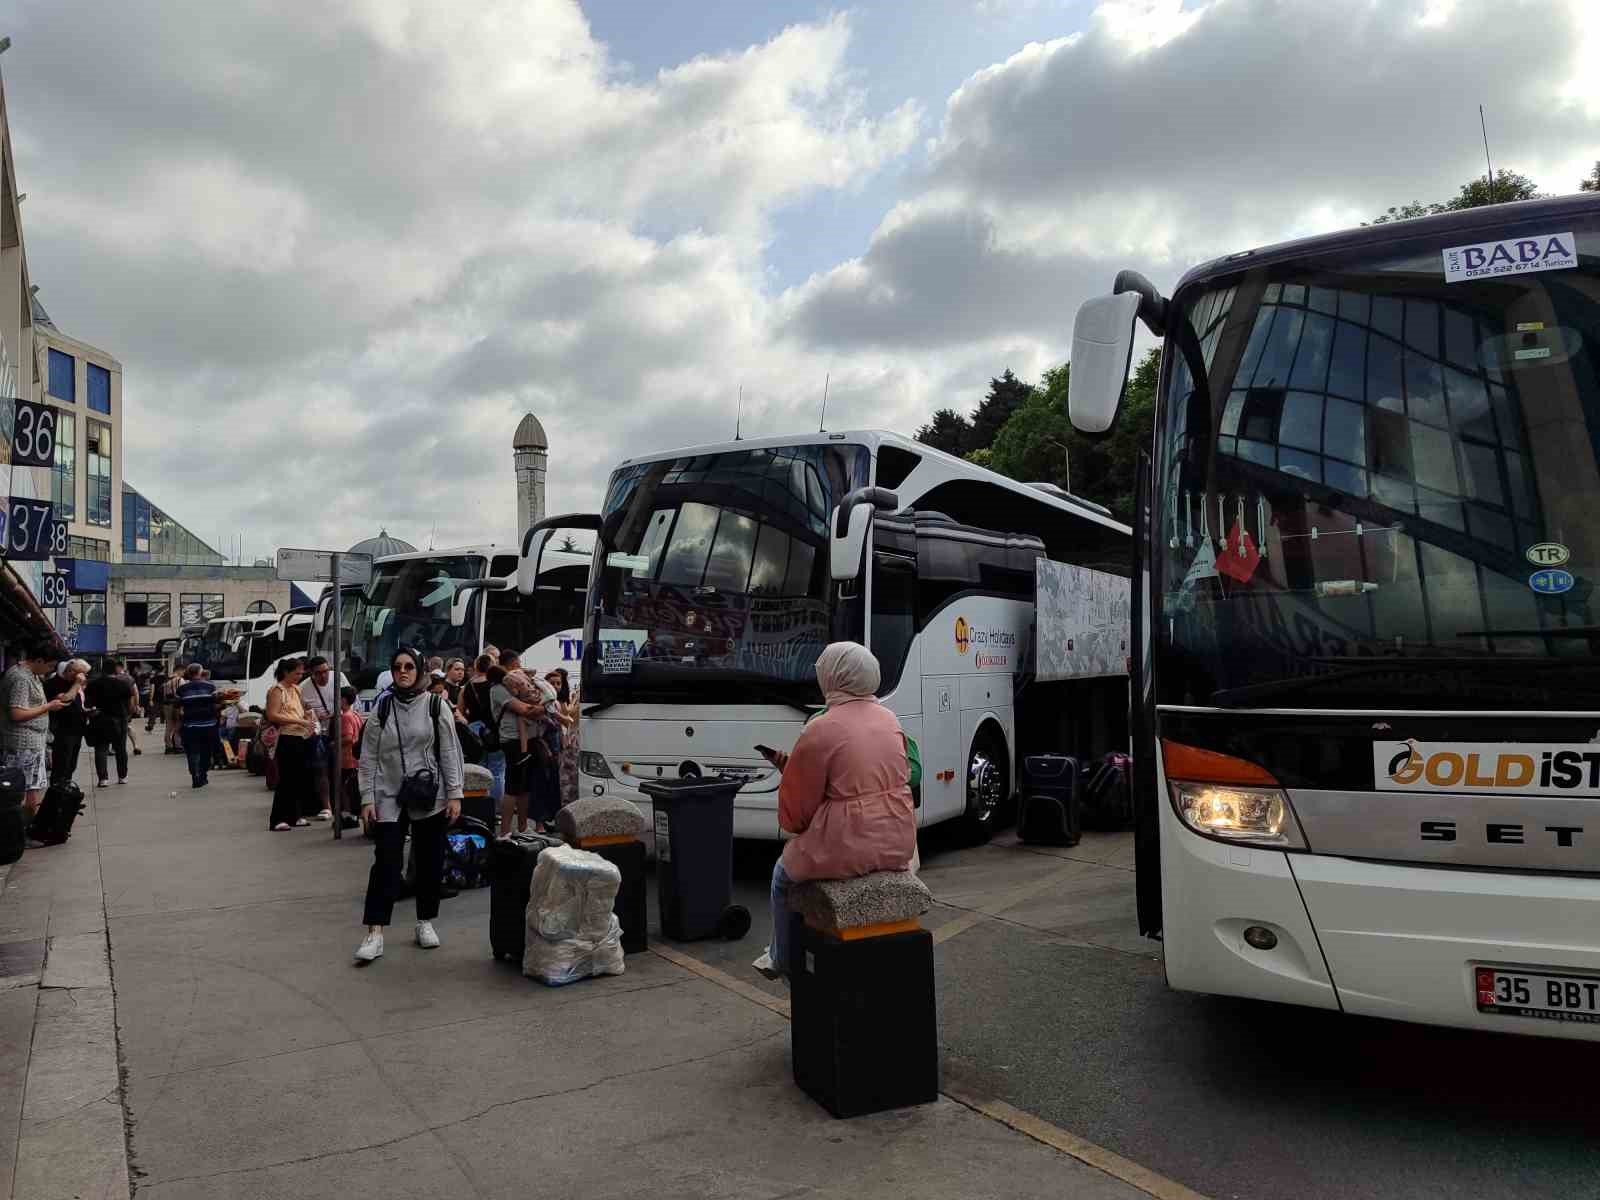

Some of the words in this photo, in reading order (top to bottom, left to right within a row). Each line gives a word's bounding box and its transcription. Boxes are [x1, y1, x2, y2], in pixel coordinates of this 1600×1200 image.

[1462, 237, 1571, 269] BABA
[15, 406, 54, 460] 36
[12, 504, 50, 553] 37
[1535, 548, 1561, 561] TR
[44, 576, 66, 605] 39
[969, 627, 988, 646] Crazy
[989, 627, 1016, 646] Holidays
[1420, 821, 1584, 847] SET
[1496, 976, 1530, 1004] 35
[1546, 980, 1599, 1010] BBT
